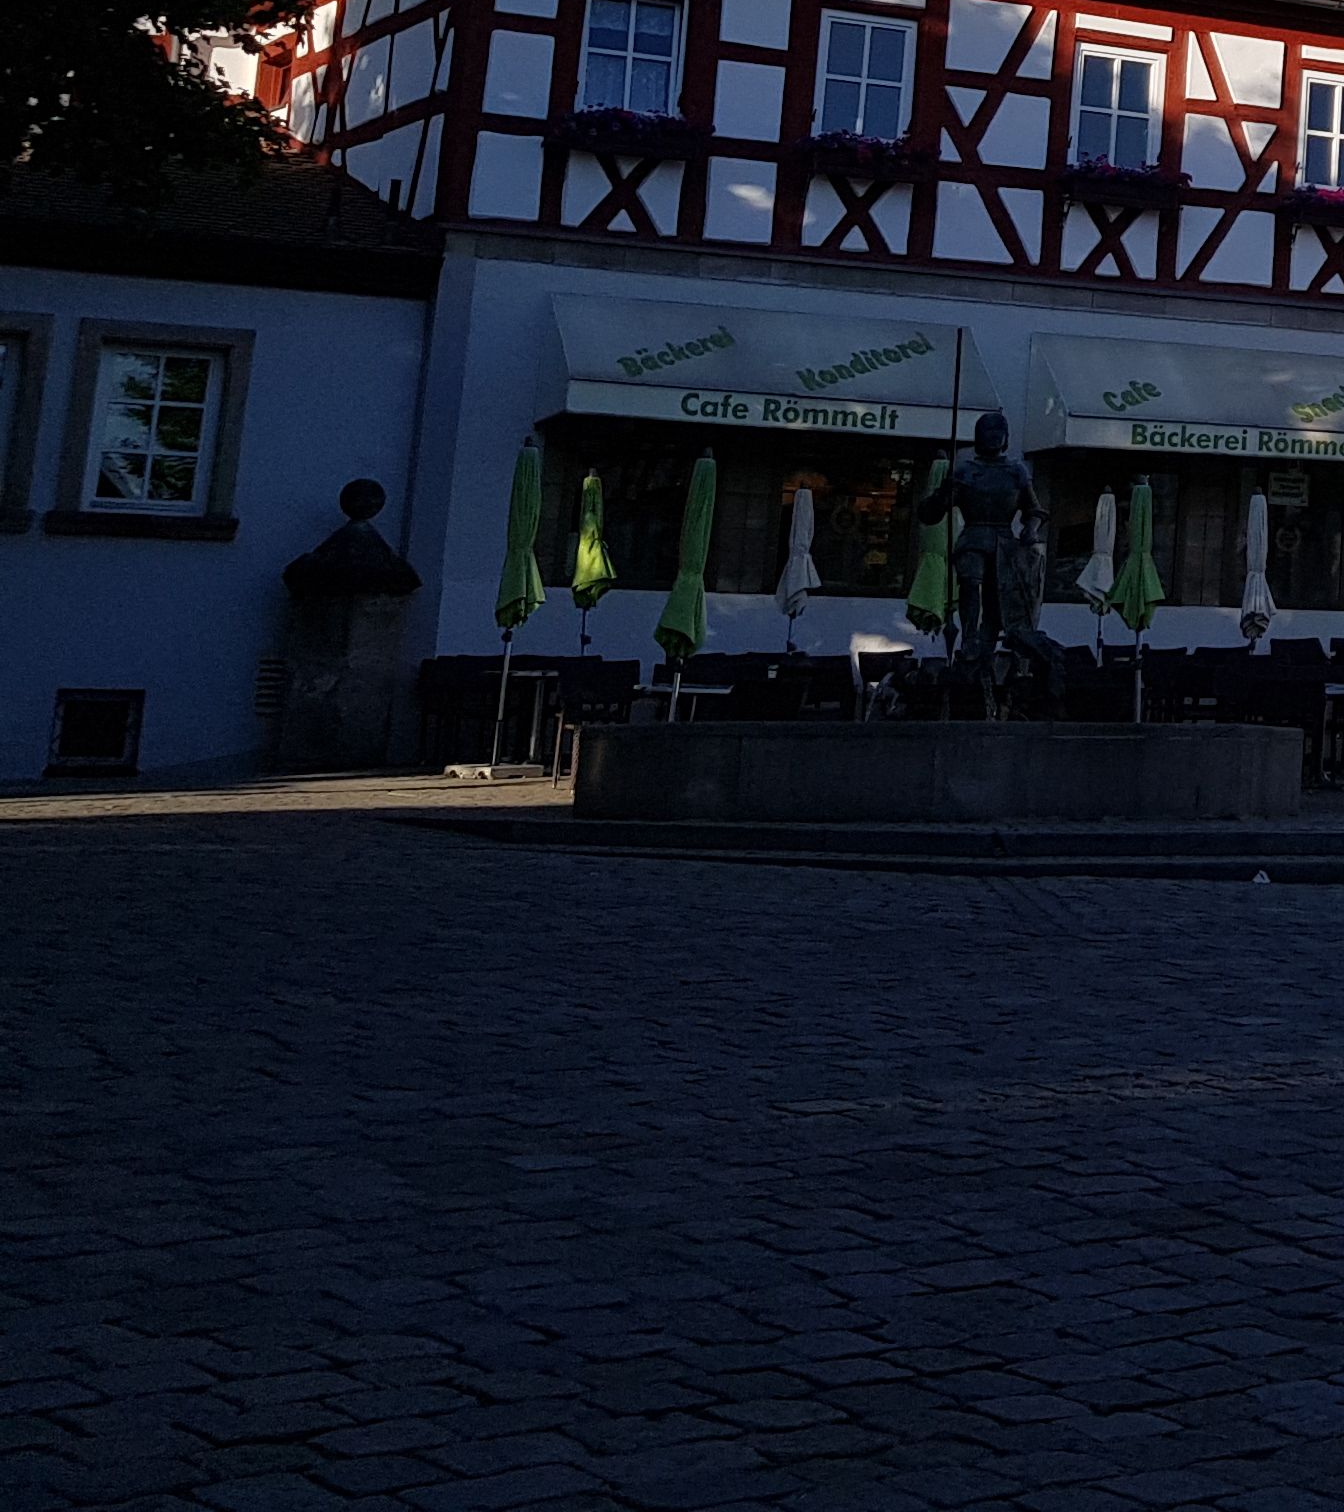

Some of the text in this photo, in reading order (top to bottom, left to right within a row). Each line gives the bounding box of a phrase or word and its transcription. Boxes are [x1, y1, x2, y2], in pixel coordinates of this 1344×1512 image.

[617, 326, 736, 377] Bäckerei
[796, 331, 935, 391] Konditorei
[680, 392, 899, 431] Cafe Römmelt
[1102, 380, 1162, 412] Cafe
[1130, 423, 1248, 451] Bäckerei
